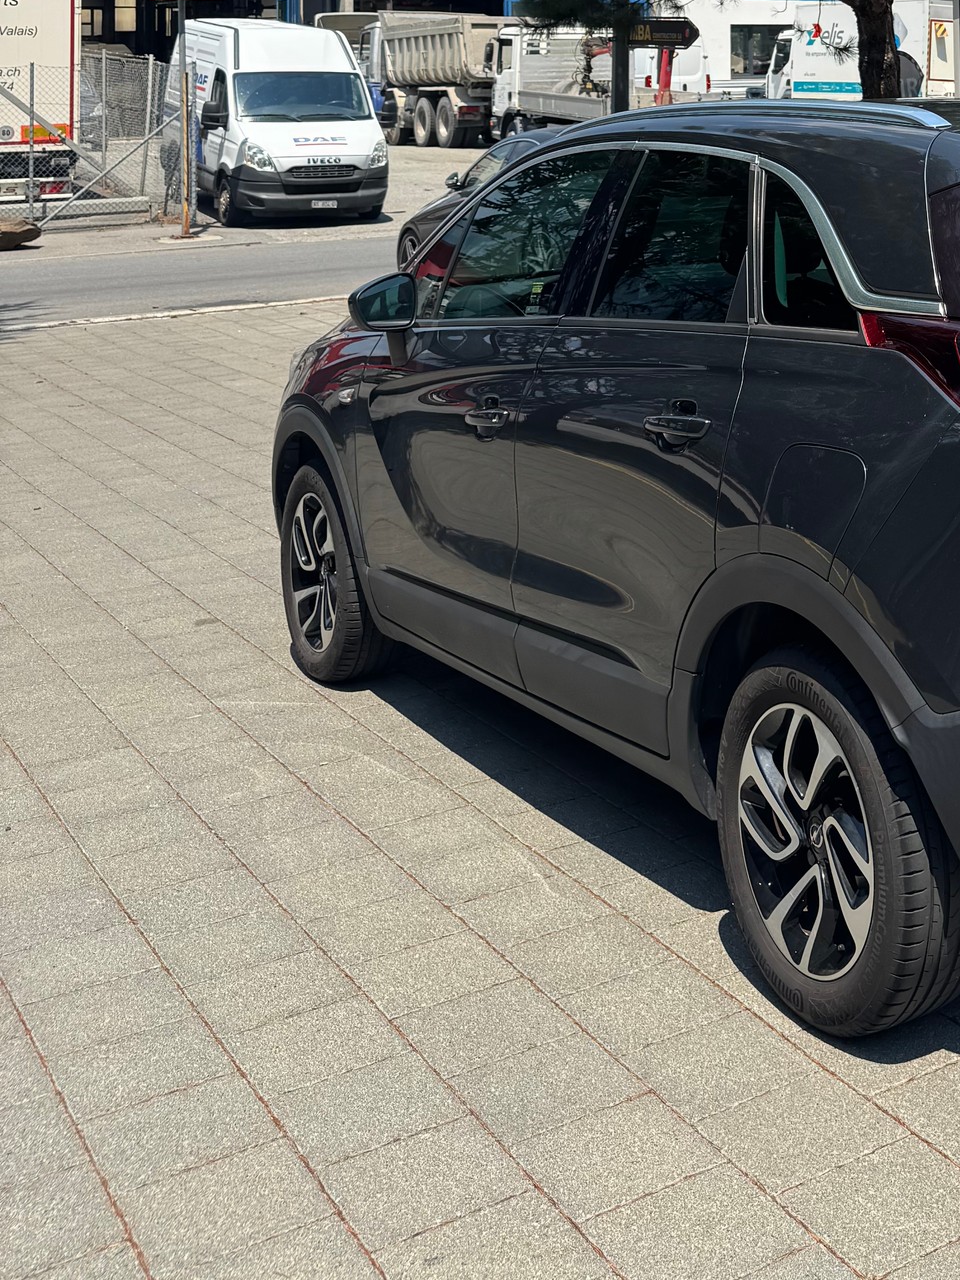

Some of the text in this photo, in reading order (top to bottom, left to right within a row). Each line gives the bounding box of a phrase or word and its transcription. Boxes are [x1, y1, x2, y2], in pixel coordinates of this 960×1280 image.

[820, 22, 845, 46] elis
[292, 136, 347, 144] DAF
[307, 157, 342, 165] IVECO
[785, 671, 849, 742] Continental
